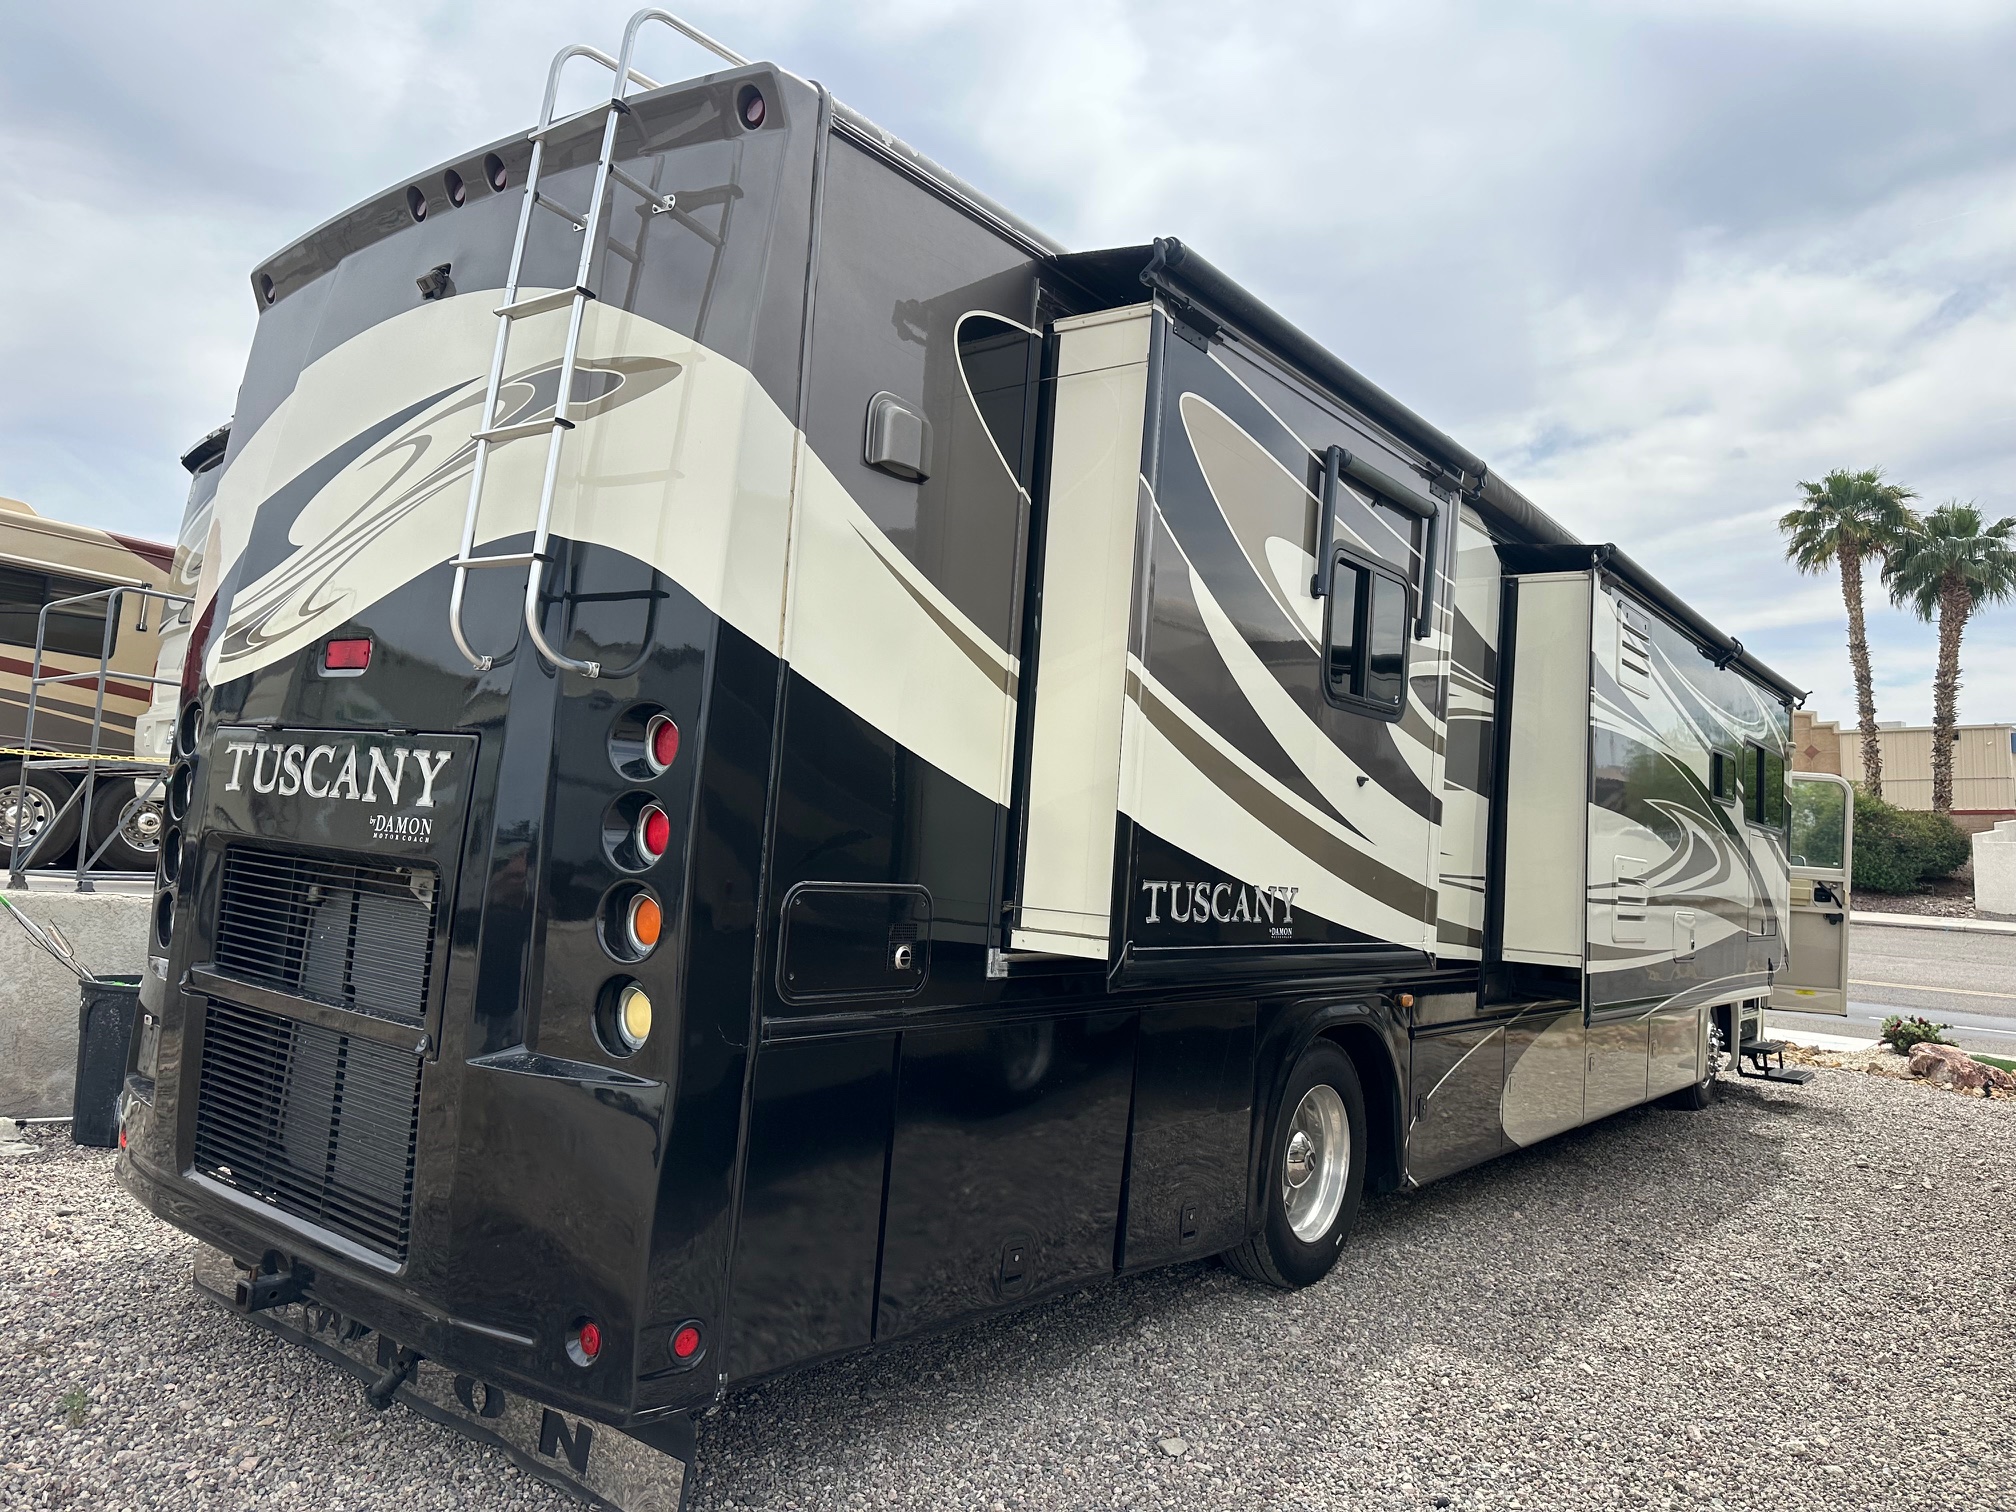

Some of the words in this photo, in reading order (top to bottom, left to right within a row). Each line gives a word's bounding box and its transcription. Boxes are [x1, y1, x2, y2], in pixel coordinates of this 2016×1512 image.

[225, 741, 451, 807] TUSCANY
[374, 814, 434, 835] DAMON
[1142, 879, 1298, 923] TUSCANY
